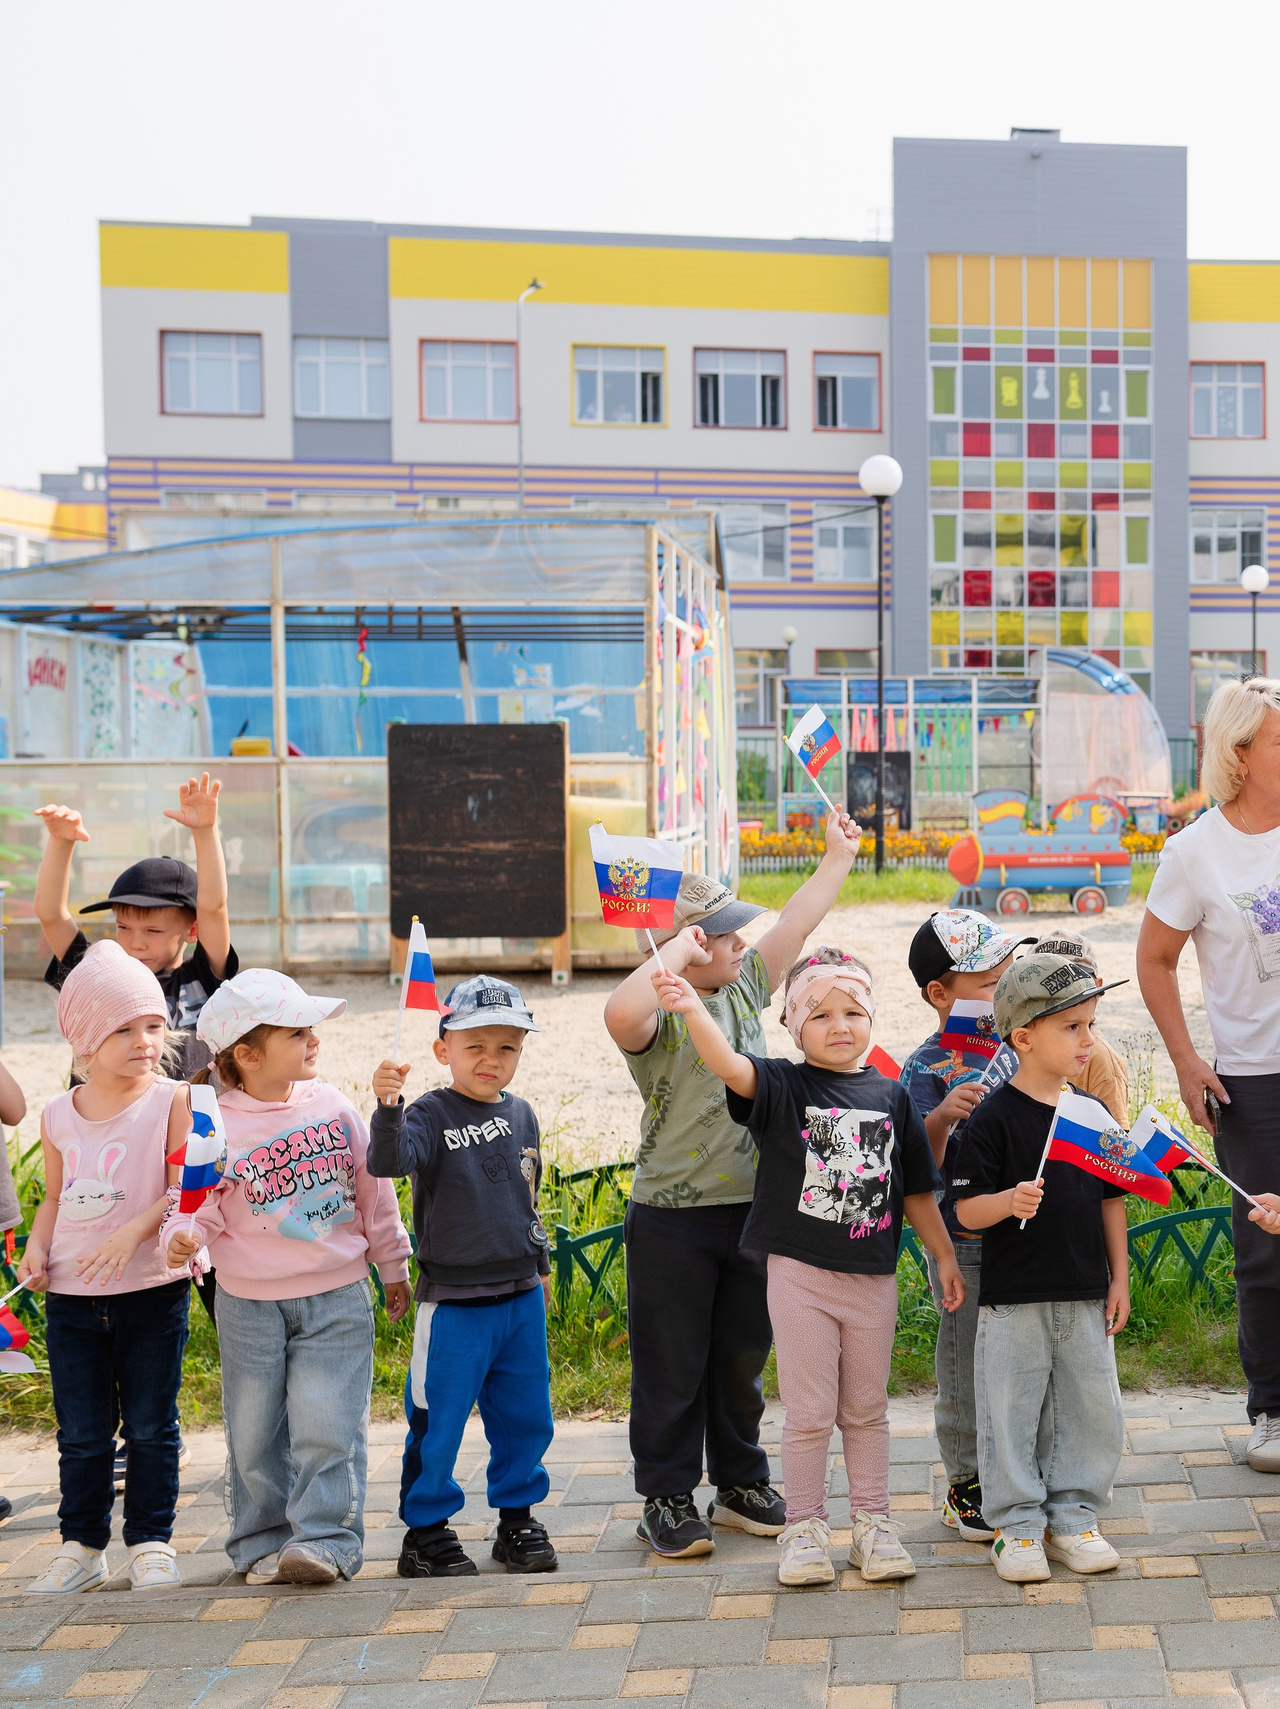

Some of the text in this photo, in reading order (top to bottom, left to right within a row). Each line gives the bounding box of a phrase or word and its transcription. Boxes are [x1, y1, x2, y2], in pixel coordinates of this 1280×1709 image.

[443, 1116, 512, 1151] SUPER
[233, 1119, 347, 1182] DREAMS
[244, 1154, 355, 1205] COME TRUE
[487, 1160, 508, 1178] BOO!
[1084, 1153, 1138, 1183] РОССИЯ
[849, 1218, 875, 1241] CAT
